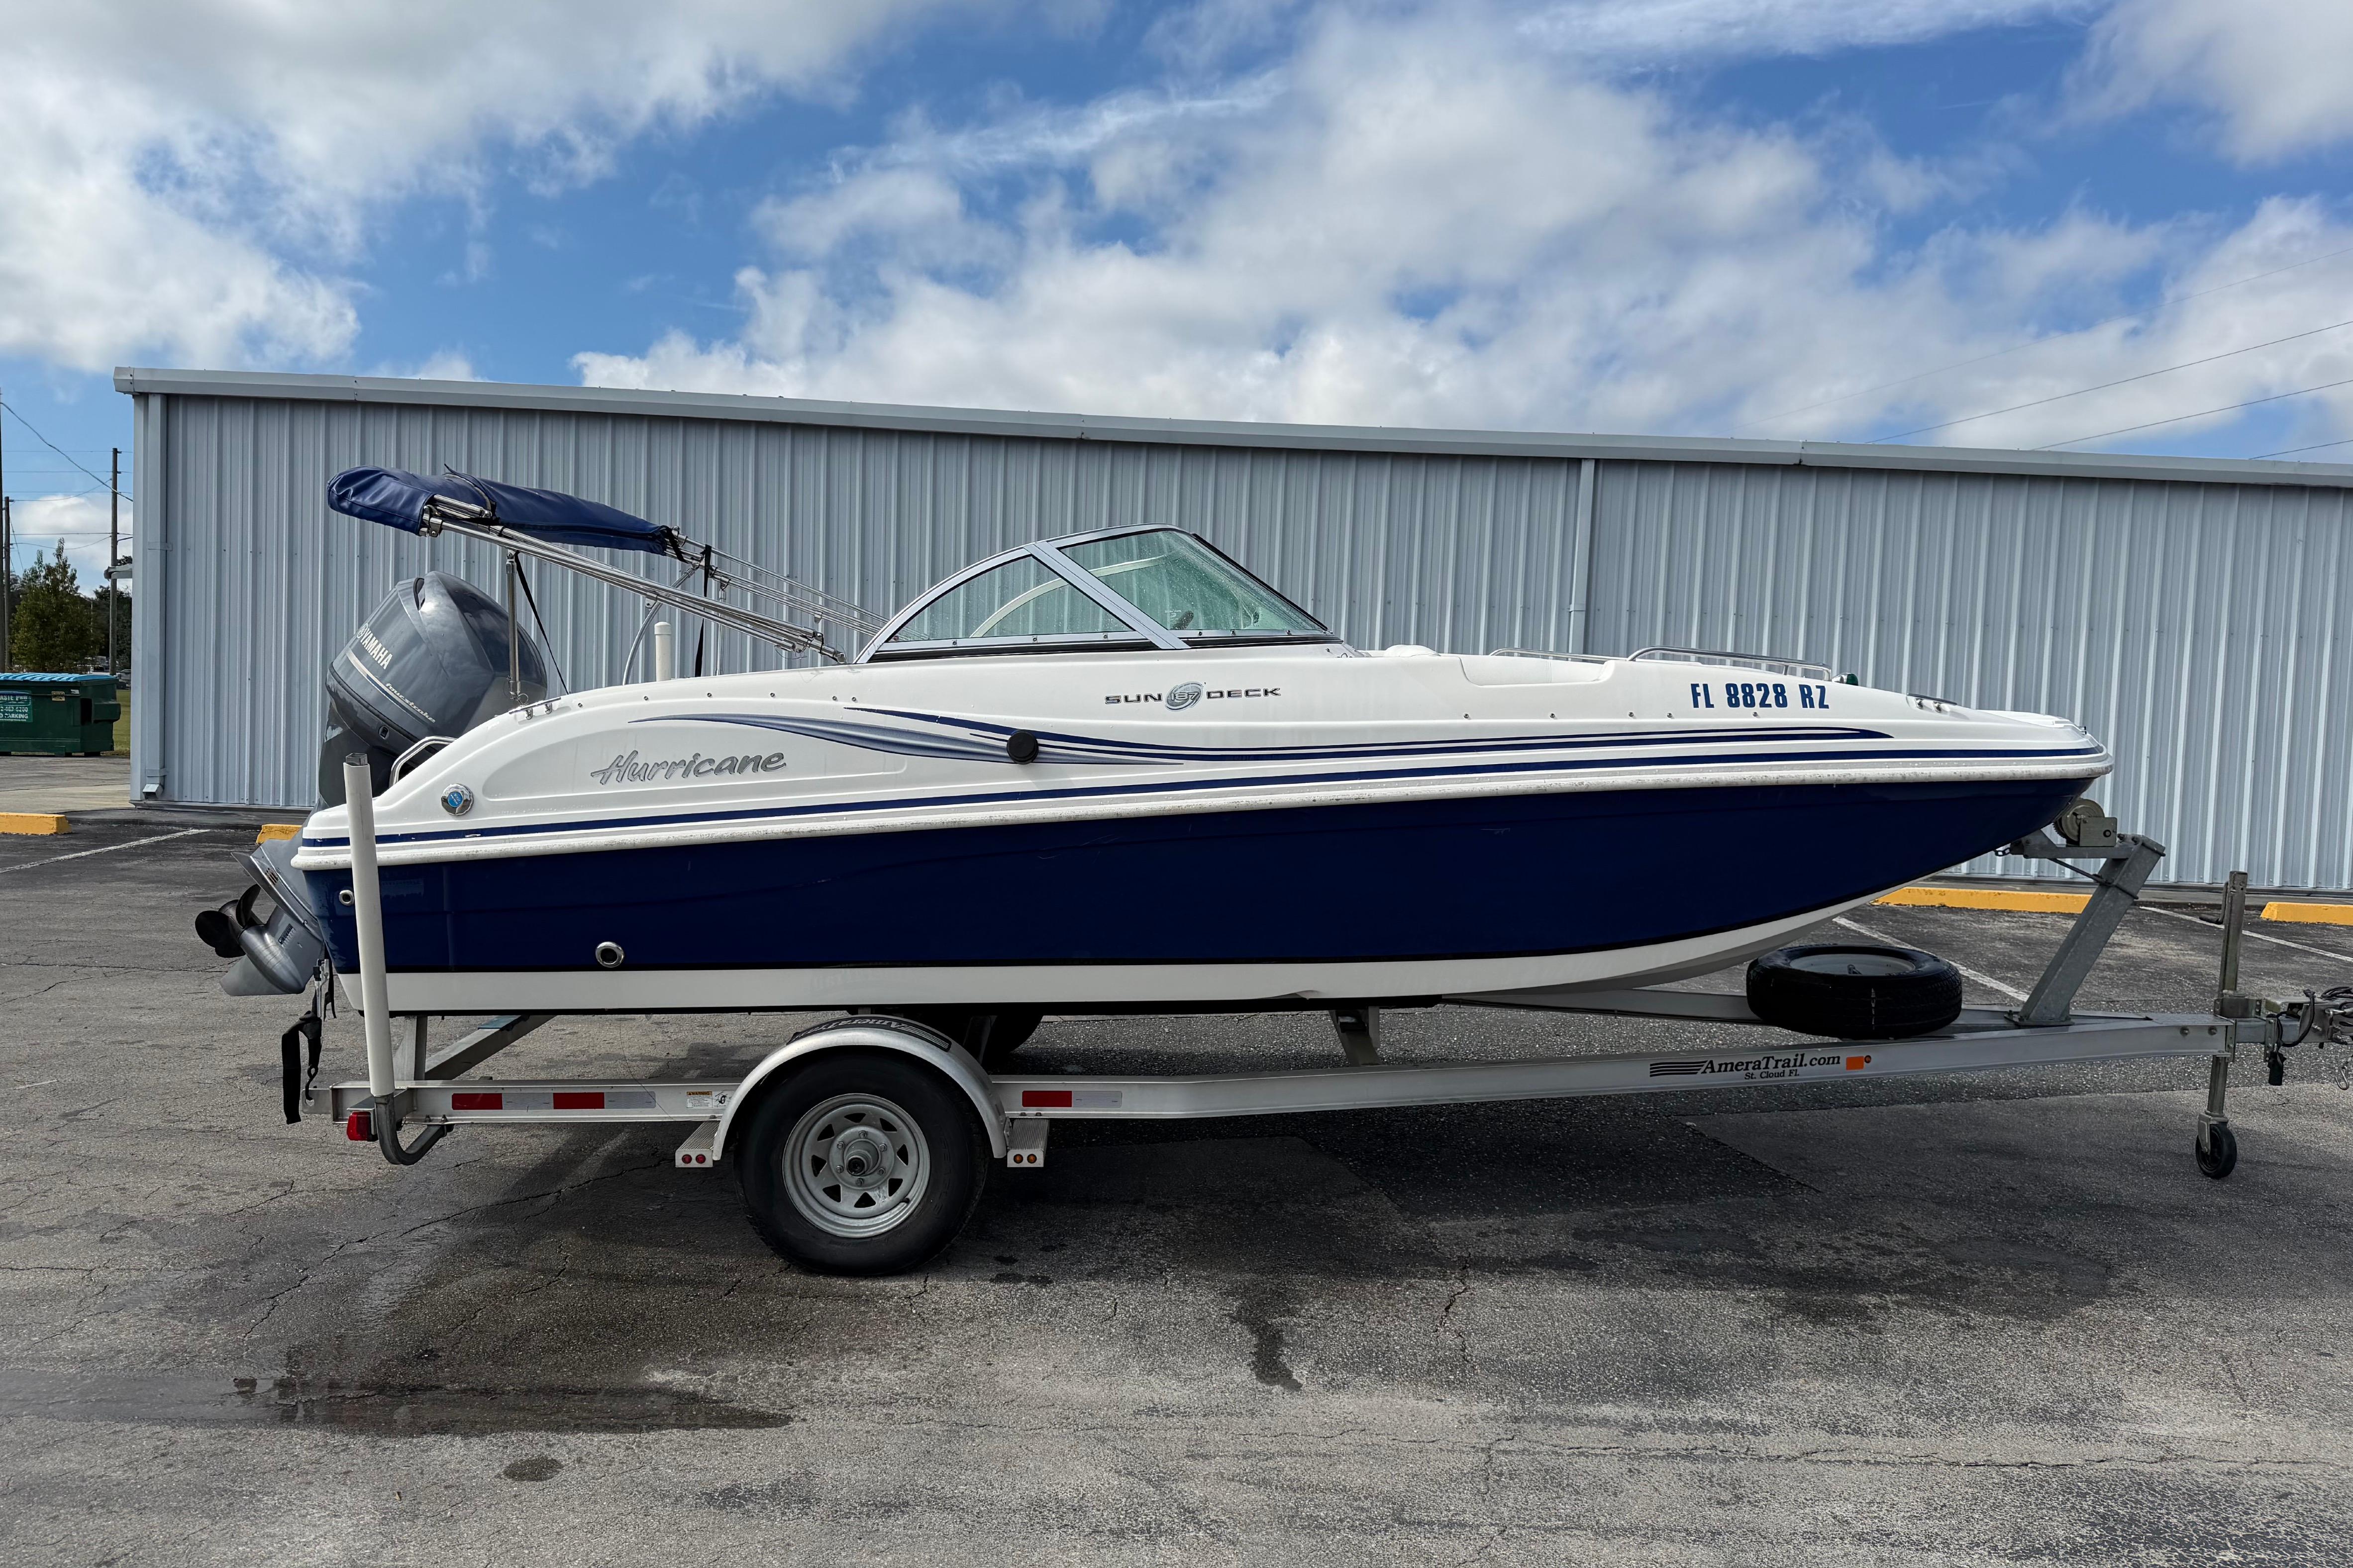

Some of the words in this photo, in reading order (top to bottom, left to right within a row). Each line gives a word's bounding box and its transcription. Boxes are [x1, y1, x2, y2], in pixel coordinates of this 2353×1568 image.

[360, 628, 393, 670] YAMAHA
[1105, 693, 1162, 704] SUN
[1170, 691, 1200, 701] 187
[1206, 687, 1281, 699] DECK
[1691, 683, 1715, 708] FL
[1725, 683, 1788, 708] 8828
[1798, 684, 1830, 709] RZ
[591, 750, 787, 785] Hurricane
[1701, 1053, 1841, 1074] AmeraTrail.com
[1744, 1072, 1756, 1080] St.
[1760, 1071, 1785, 1079] Cloud
